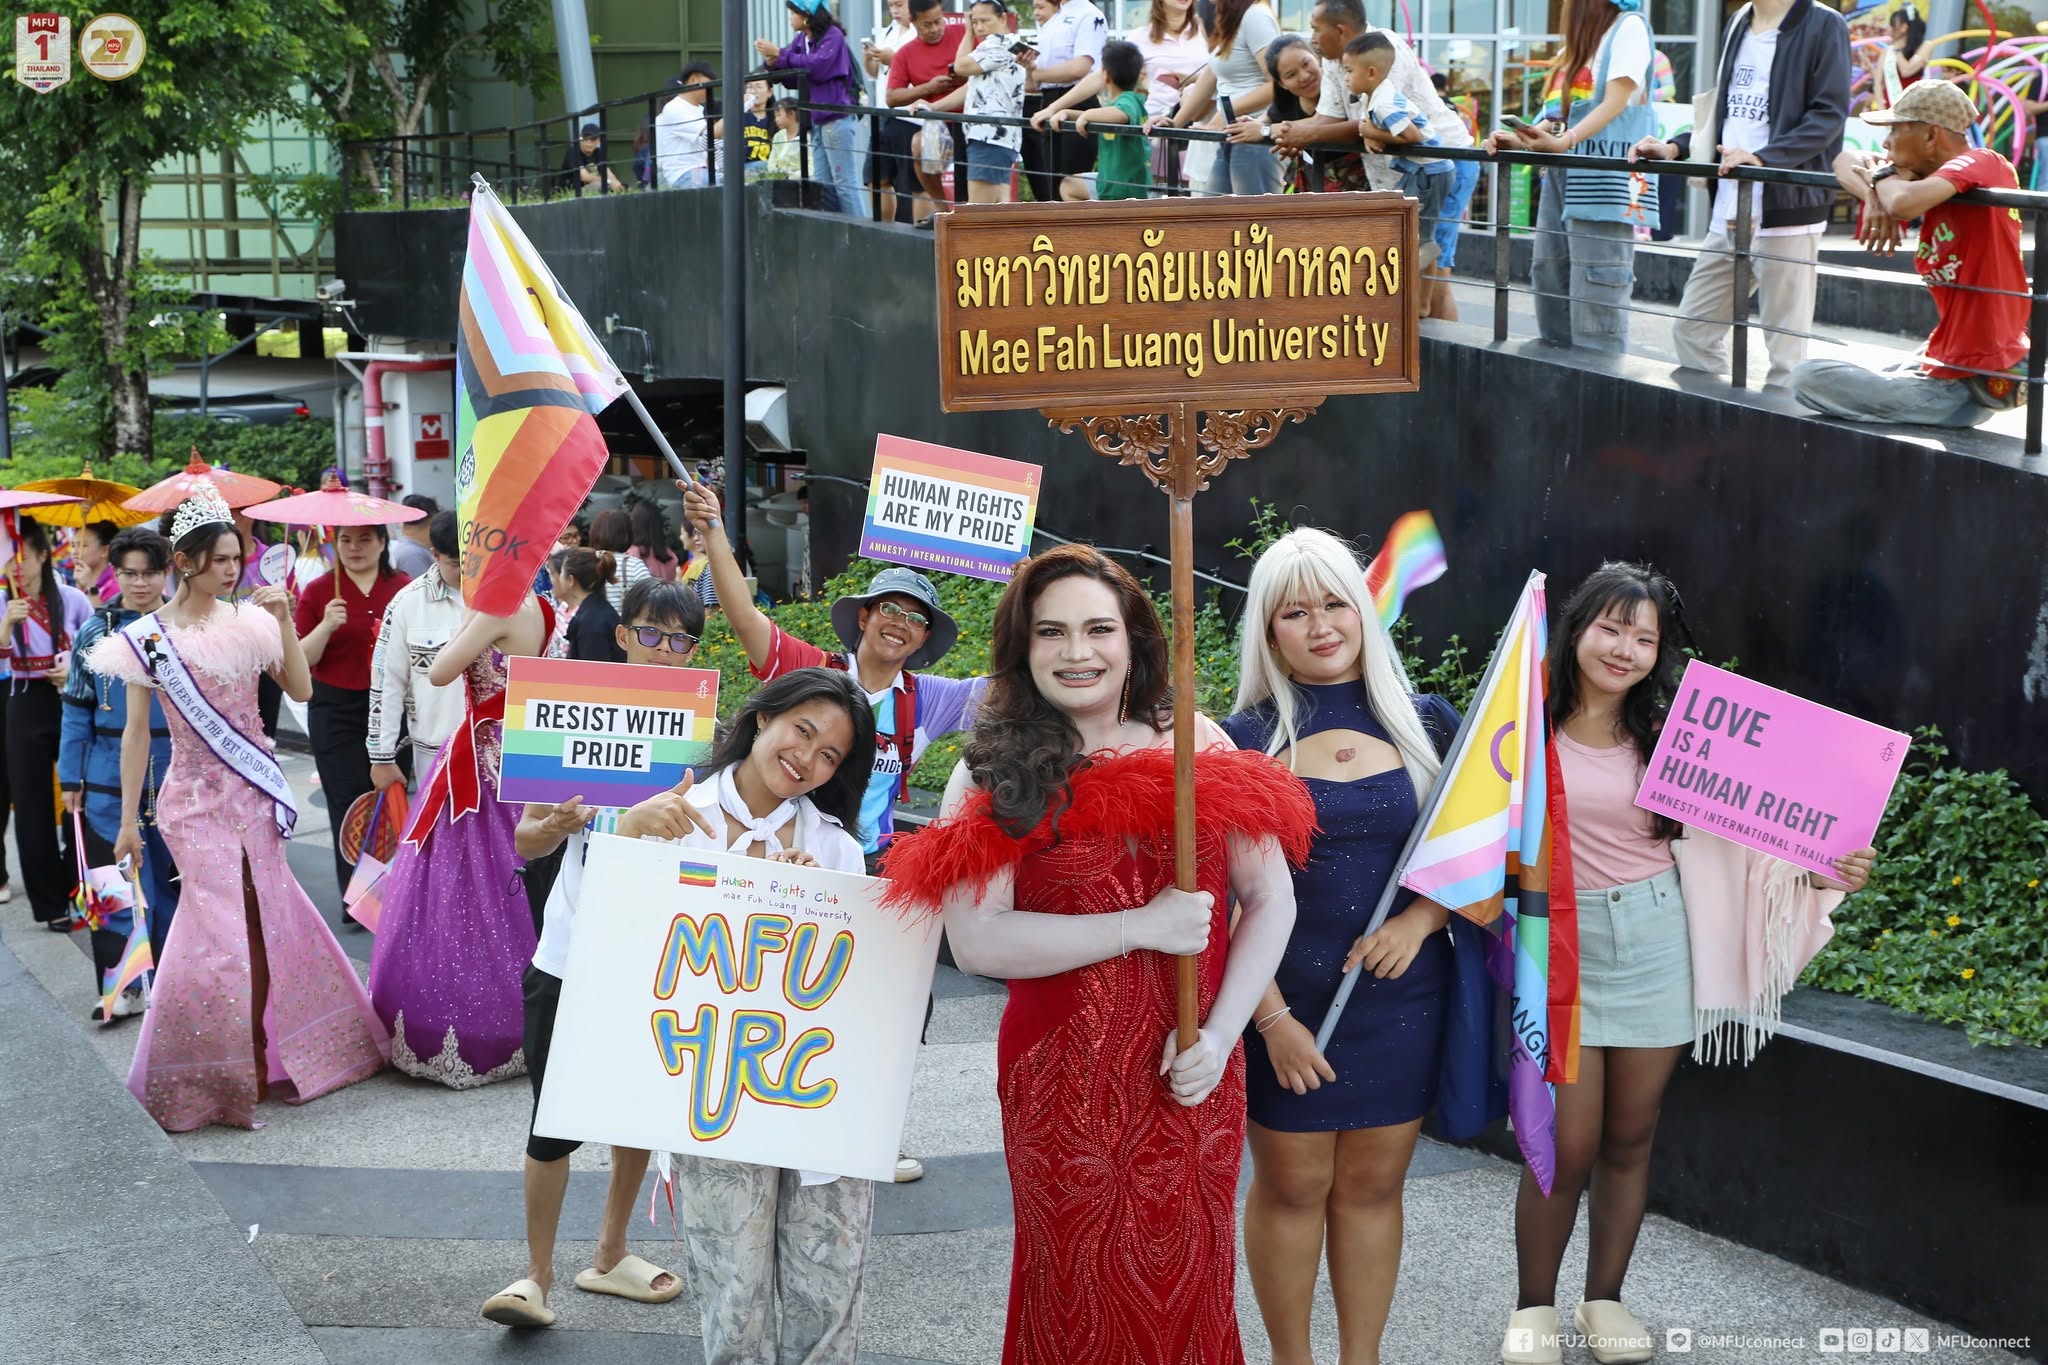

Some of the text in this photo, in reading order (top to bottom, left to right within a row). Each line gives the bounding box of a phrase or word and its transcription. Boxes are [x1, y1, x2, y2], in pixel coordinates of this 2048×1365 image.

[955, 223, 1399, 308] มหาวิทยาลัยแม่ฟ้าหลวง
[959, 313, 1390, 379] Mae Fah Luang University
[881, 500, 1017, 546] ARE MY PRIDE
[883, 474, 1024, 522] HUMAN RIGHTS
[868, 541, 908, 557] AMNESTY
[910, 549, 975, 570] INTERNATIONAL
[168, 672, 195, 708] QUEEN
[204, 719, 224, 739] THE
[219, 735, 241, 756] NEXT
[535, 702, 685, 737] RESIST WITH
[1681, 687, 1772, 748] LOVE
[571, 740, 644, 769] PRIDE
[1671, 727, 1713, 761] IS A
[1658, 755, 1839, 841] HUMAN RIGHT
[1649, 789, 1835, 868] AMNESTY INTERNATIONAL THAILA
[769, 880, 806, 898] Rights
[769, 900, 797, 915] Luang
[804, 907, 853, 924] University
[653, 912, 855, 1011] MFU
[651, 1003, 838, 1142] HRC
